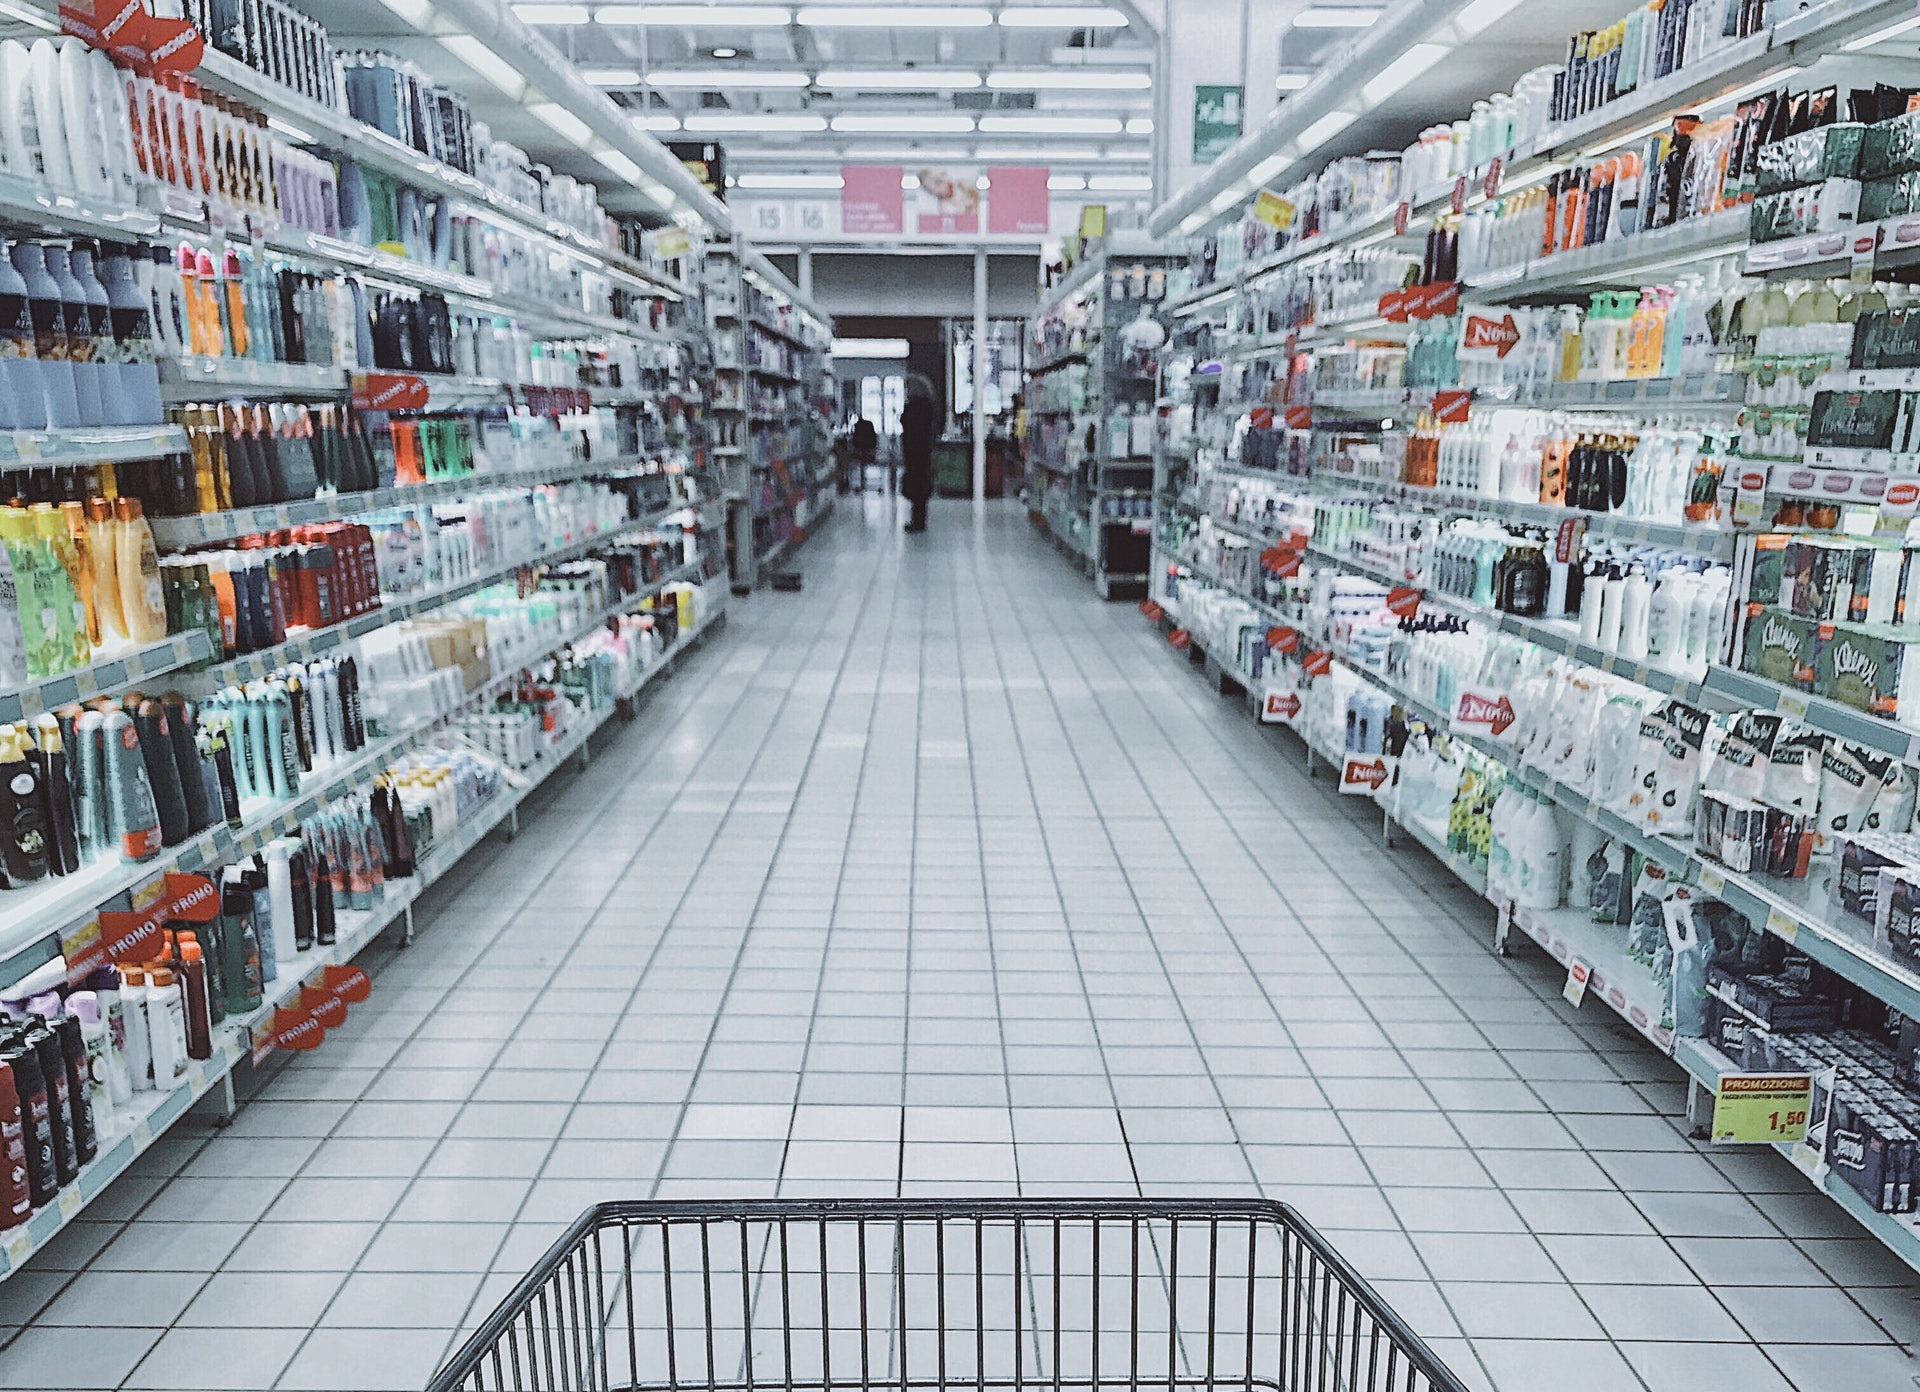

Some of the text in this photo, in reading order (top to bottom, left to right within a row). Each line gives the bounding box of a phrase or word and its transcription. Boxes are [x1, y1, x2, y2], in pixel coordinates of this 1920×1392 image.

[102, 0, 140, 41] PROMO
[150, 27, 197, 64] PROMO
[759, 207, 780, 229] 15
[802, 207, 823, 229] 16
[371, 380, 407, 407] PROMO
[171, 883, 214, 915] PROMO
[107, 920, 156, 958] PROMO
[279, 1017, 318, 1045] PROMO
[1724, 1079, 1804, 1090] PROMOZIONE
[1769, 1111, 1806, 1134] 1,50
